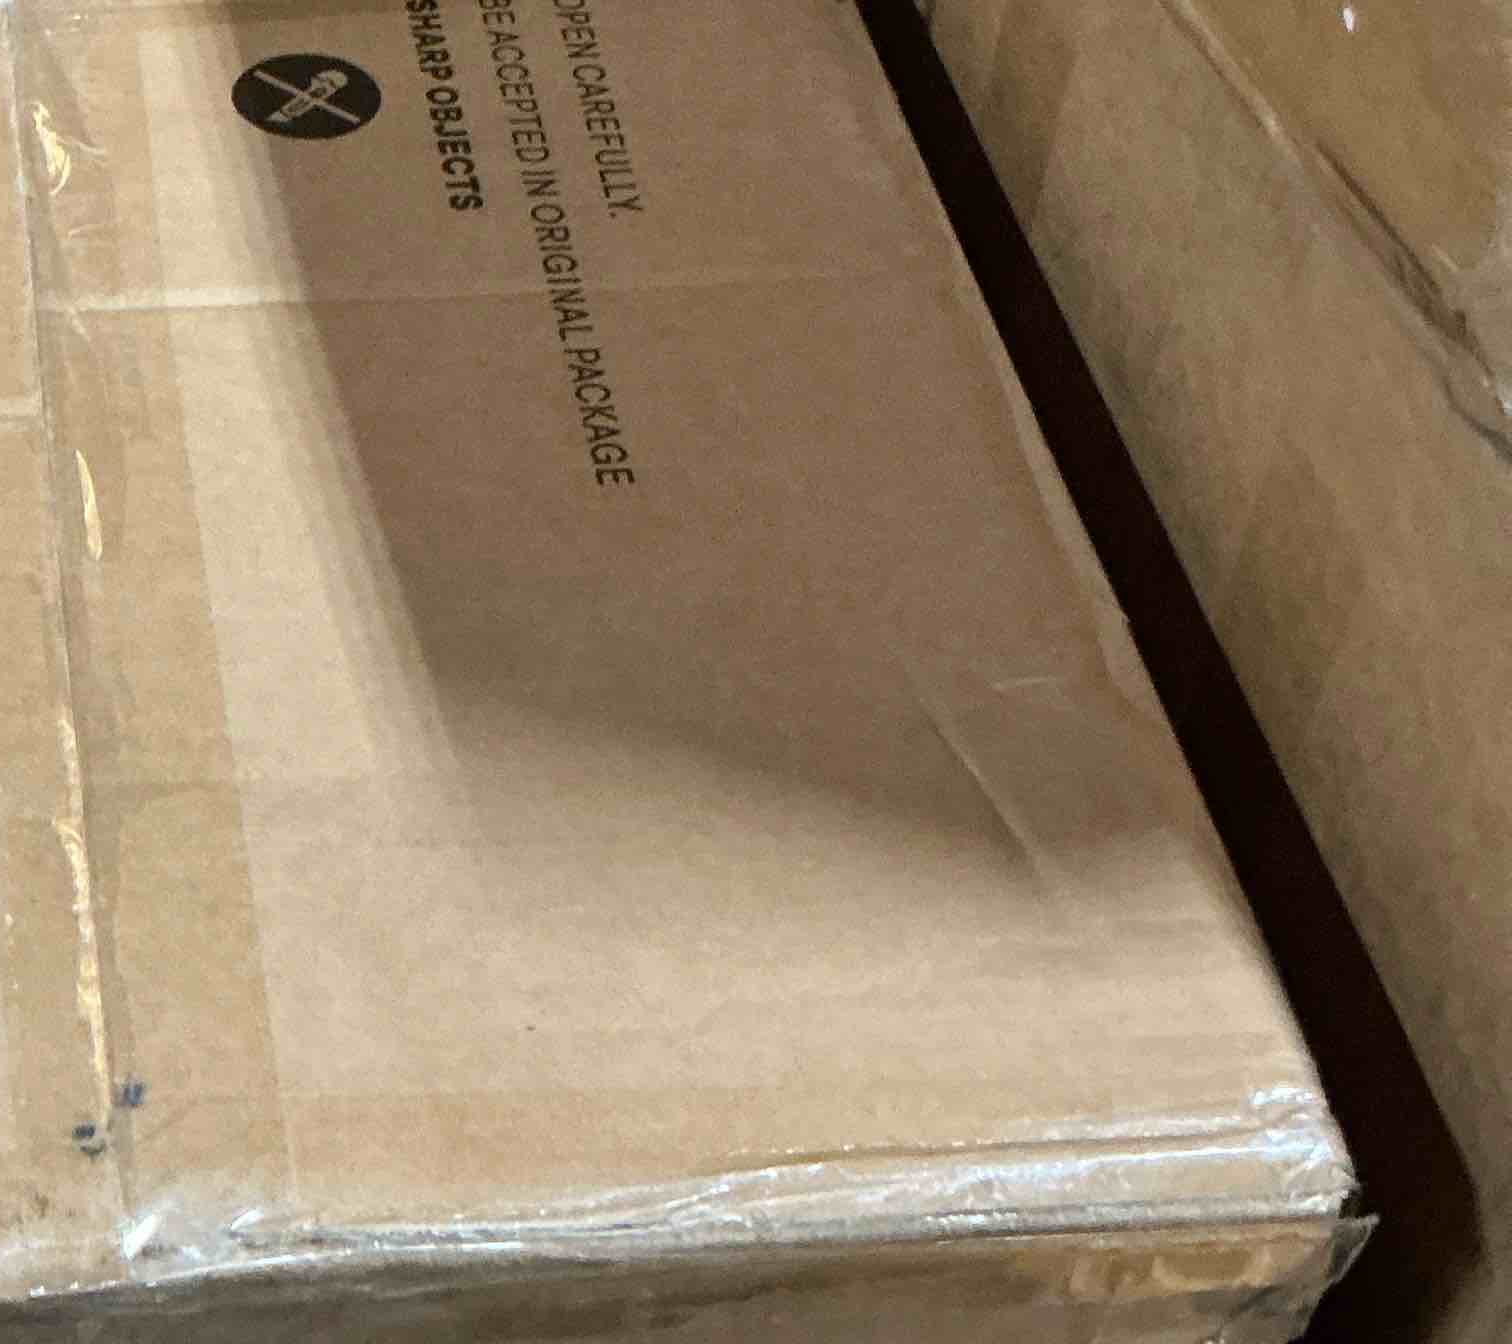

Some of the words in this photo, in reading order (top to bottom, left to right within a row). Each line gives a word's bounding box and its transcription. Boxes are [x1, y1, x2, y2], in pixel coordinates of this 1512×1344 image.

[425, 85, 484, 212] OBJECTS
[486, 30, 551, 164] ACCEPTED
[571, 61, 645, 220] CAREFULLY.
[520, 170, 564, 199] IN
[530, 202, 594, 343] ORIGINAL
[564, 346, 636, 487] PACKAGE
